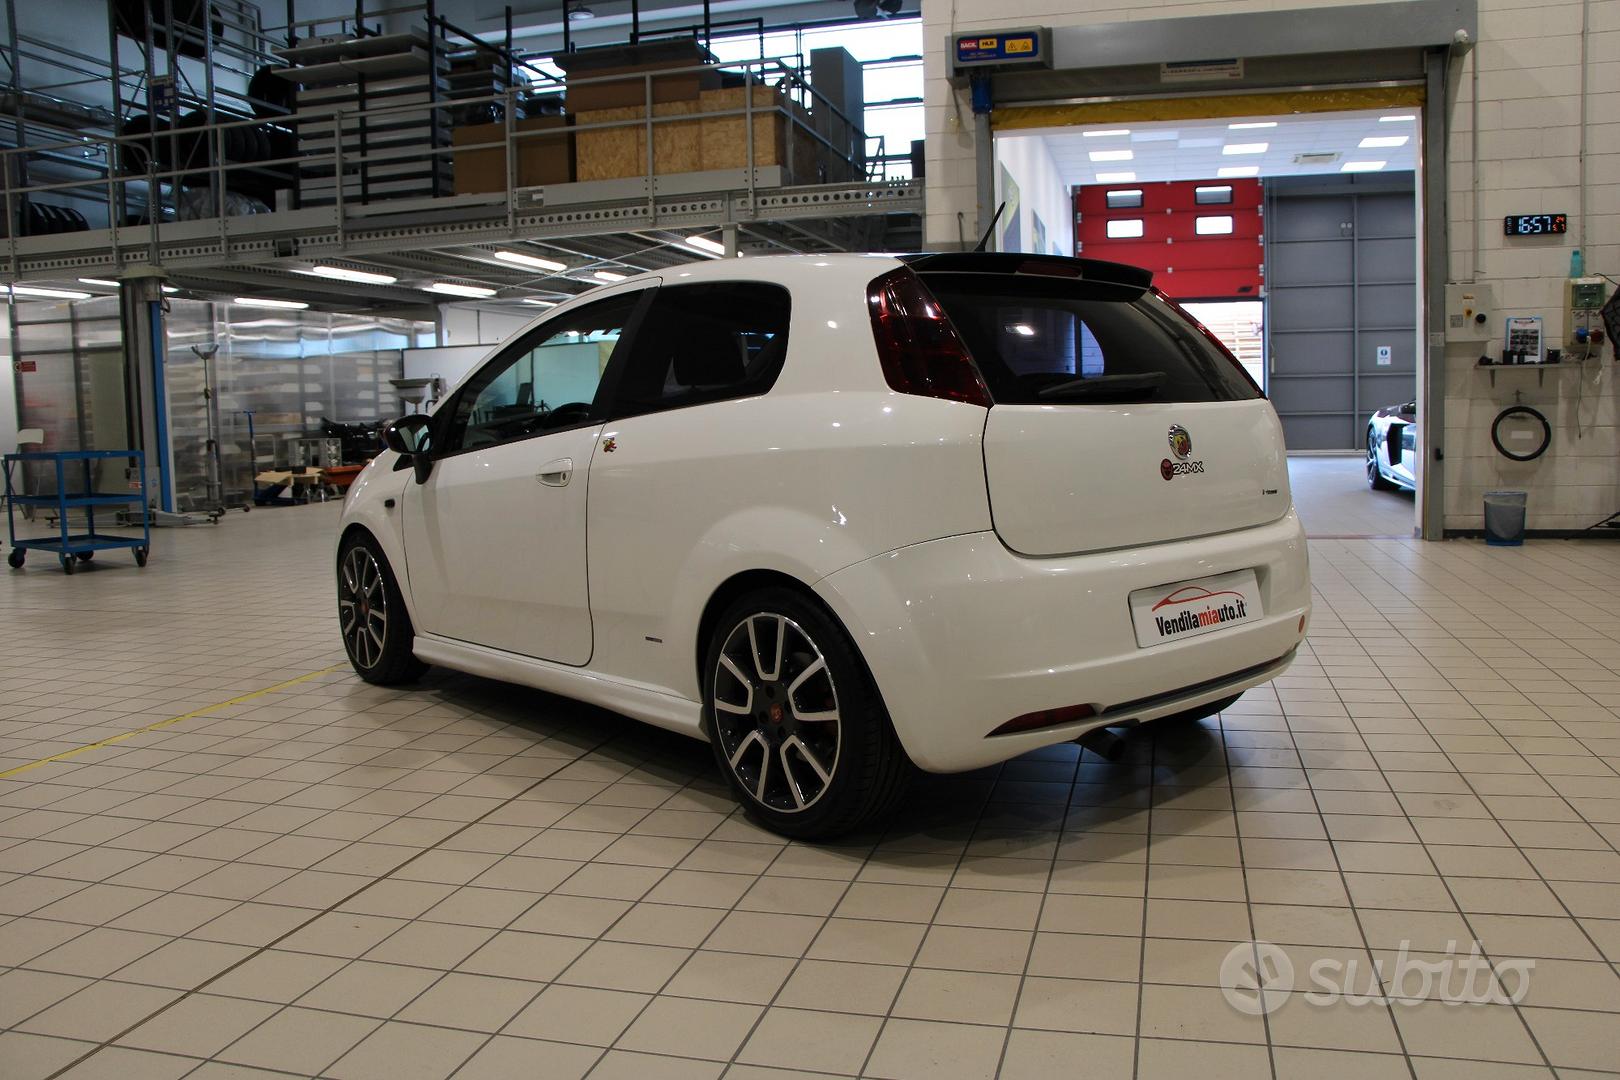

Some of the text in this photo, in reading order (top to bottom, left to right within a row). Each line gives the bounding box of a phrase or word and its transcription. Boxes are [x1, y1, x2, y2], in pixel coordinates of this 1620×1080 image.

[1518, 216, 1551, 233] 16:57
[1172, 461, 1204, 476] 24MX
[1155, 599, 1247, 636] Vendilamiauto.it
